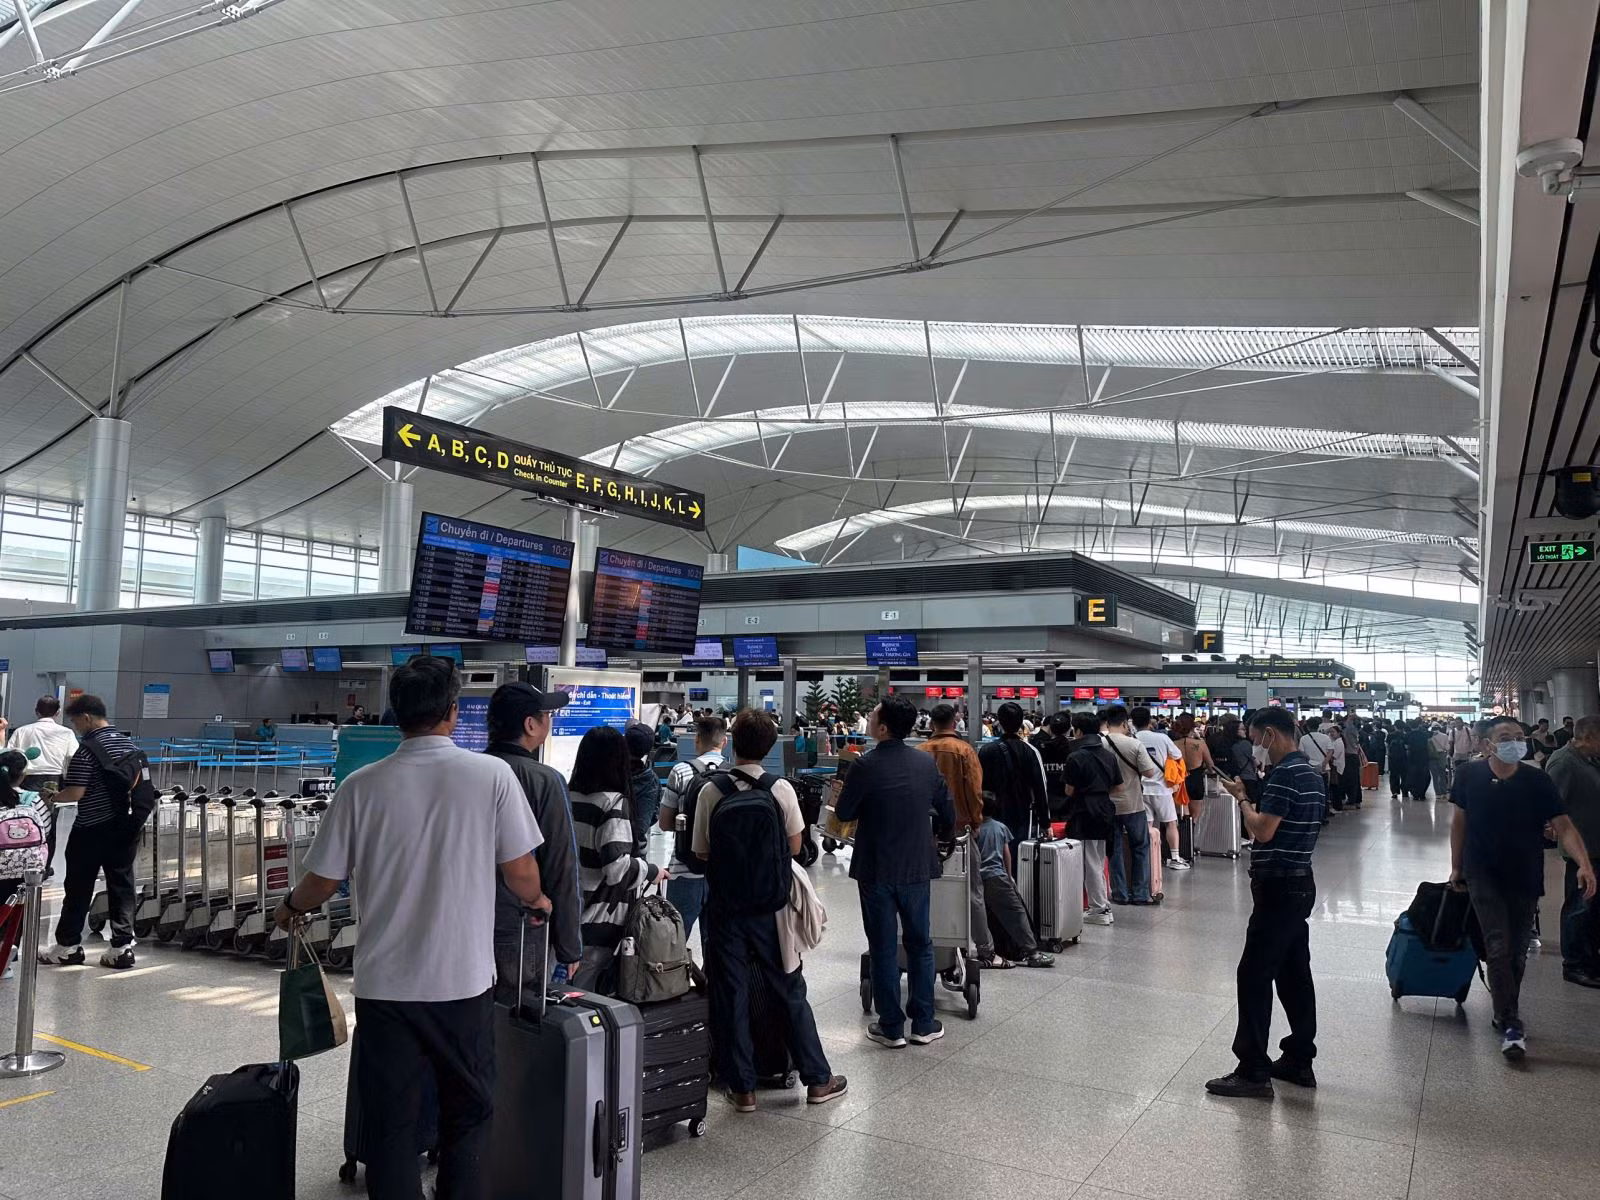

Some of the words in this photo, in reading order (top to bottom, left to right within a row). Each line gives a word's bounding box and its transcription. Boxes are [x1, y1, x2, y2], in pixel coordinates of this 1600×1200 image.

[497, 451, 509, 469] D
[513, 468, 535, 480] Check
[543, 475, 569, 488] Counter
[678, 499, 686, 515] L
[496, 533, 544, 551] Departures
[1539, 545, 1557, 553] EXIT
[648, 561, 682, 575] Departures
[1088, 599, 1106, 622] E
[1203, 633, 1217, 650] F
[1341, 677, 1351, 688] G
[1359, 682, 1367, 691] H
